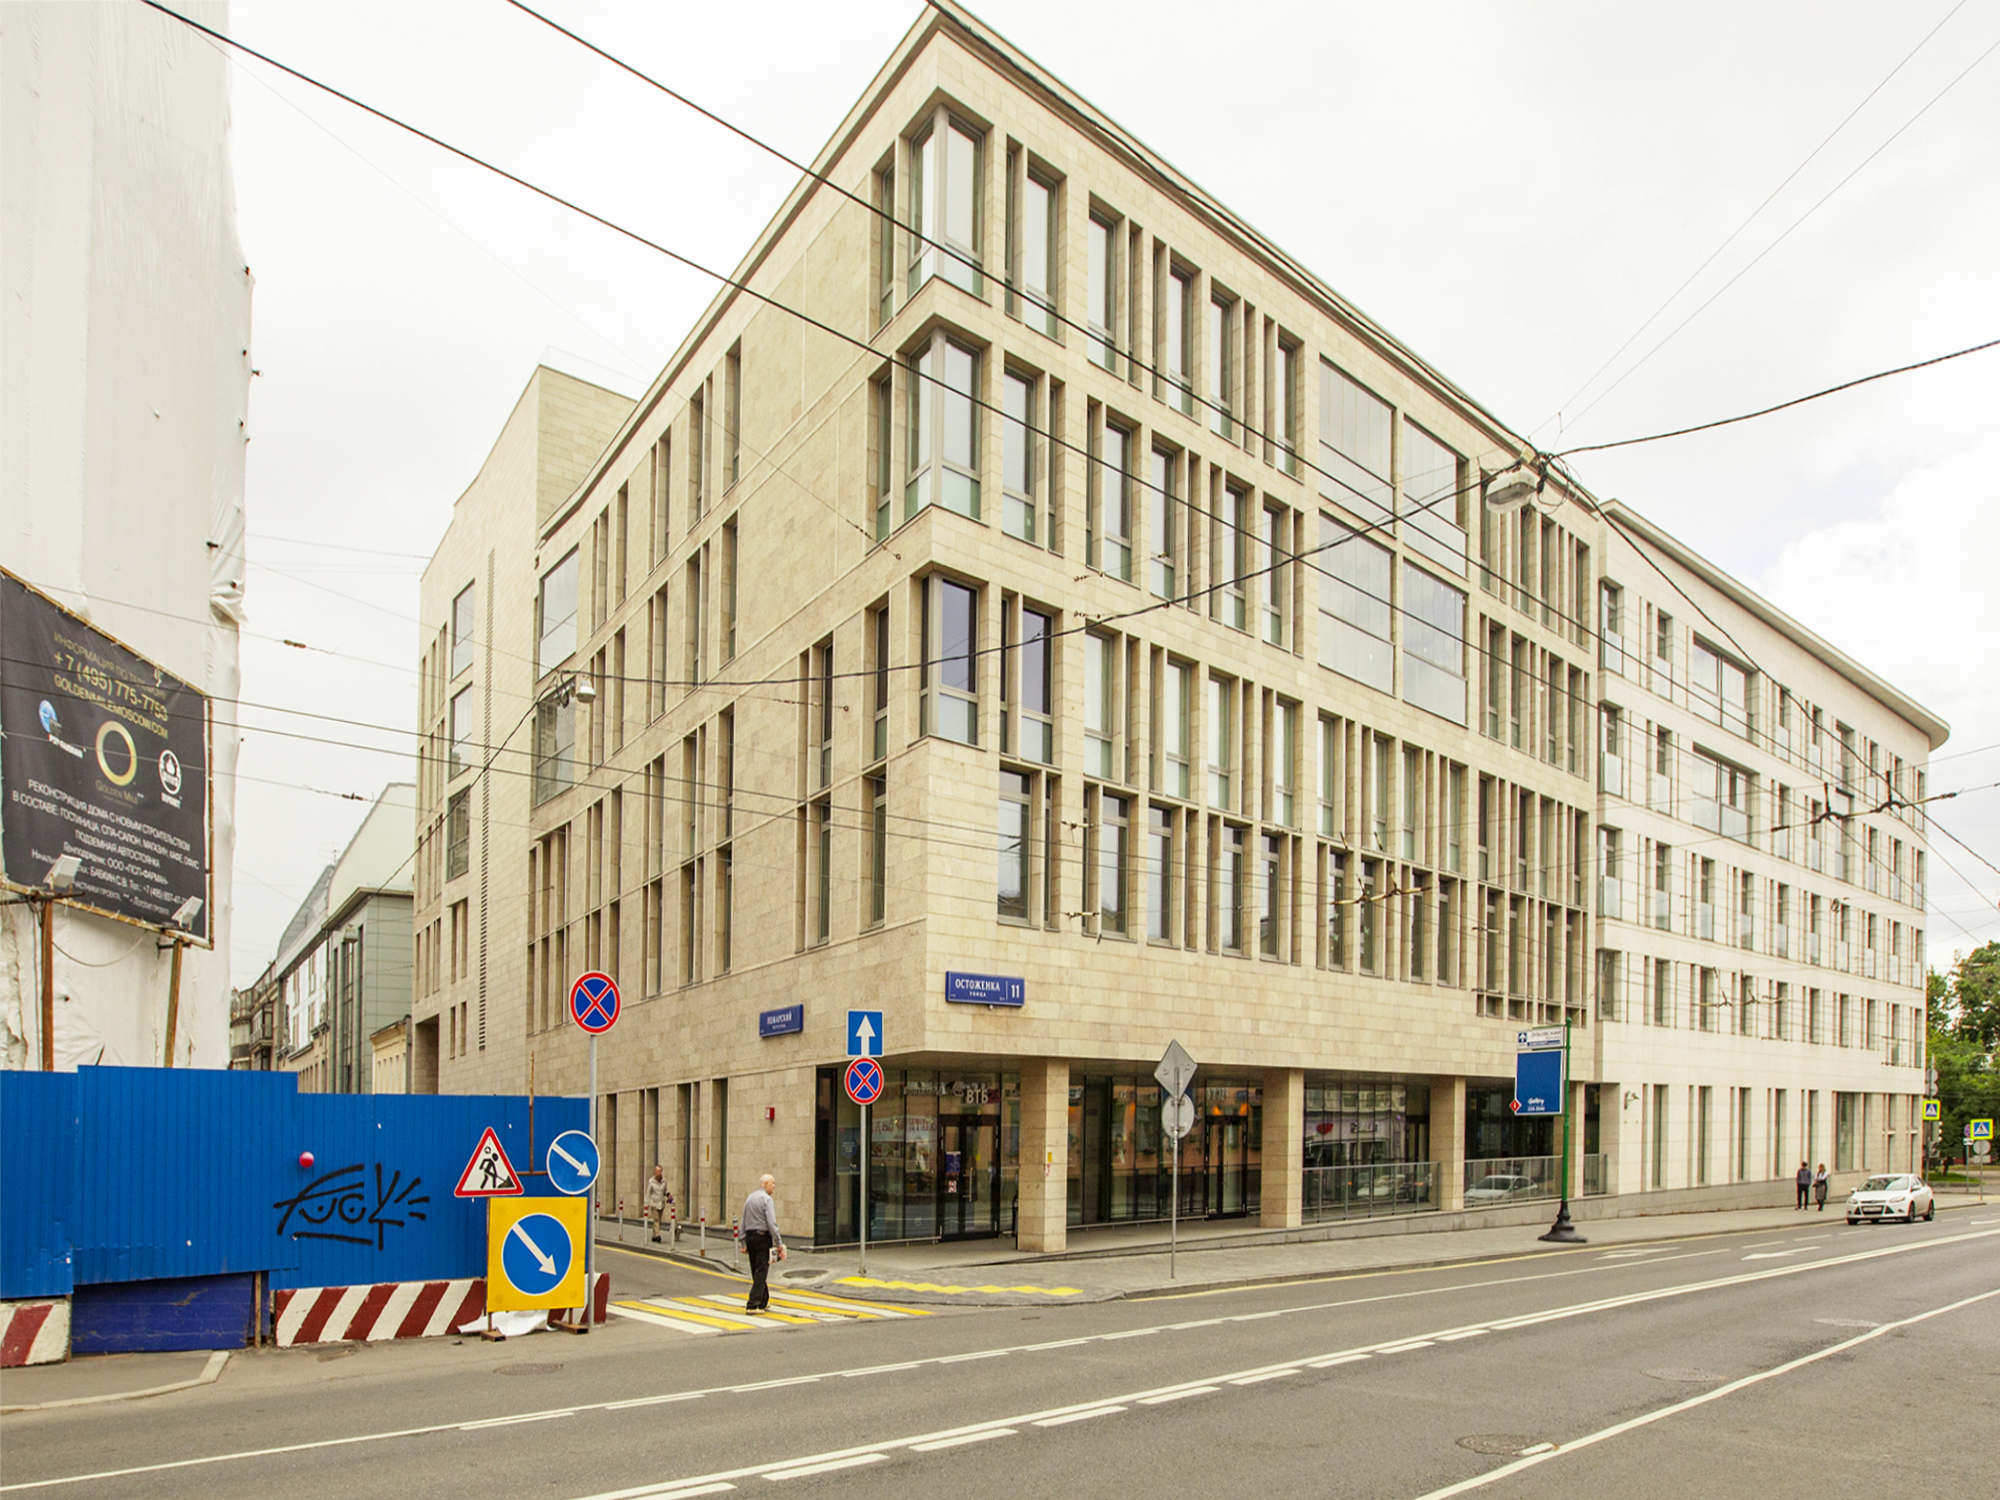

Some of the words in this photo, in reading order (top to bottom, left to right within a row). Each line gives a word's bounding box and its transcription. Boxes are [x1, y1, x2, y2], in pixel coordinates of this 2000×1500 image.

[65, 654, 74, 672] 7
[76, 659, 112, 696] (495)
[115, 679, 168, 722] 775-7753
[13, 791, 19, 801] В
[28, 780, 86, 811] РЕКОНСТРУКЦИЯ
[87, 804, 108, 821] ДОМА
[110, 813, 114, 821] С
[116, 815, 141, 830] НОВЫМ
[75, 830, 116, 852] ПОДЗЕМНАЯ
[118, 845, 159, 867] АВТОСТОЯНКА
[107, 857, 124, 871] ООО
[954, 978, 1000, 991] ОСТОЖЕНКА
[1010, 984, 1020, 998] 11
